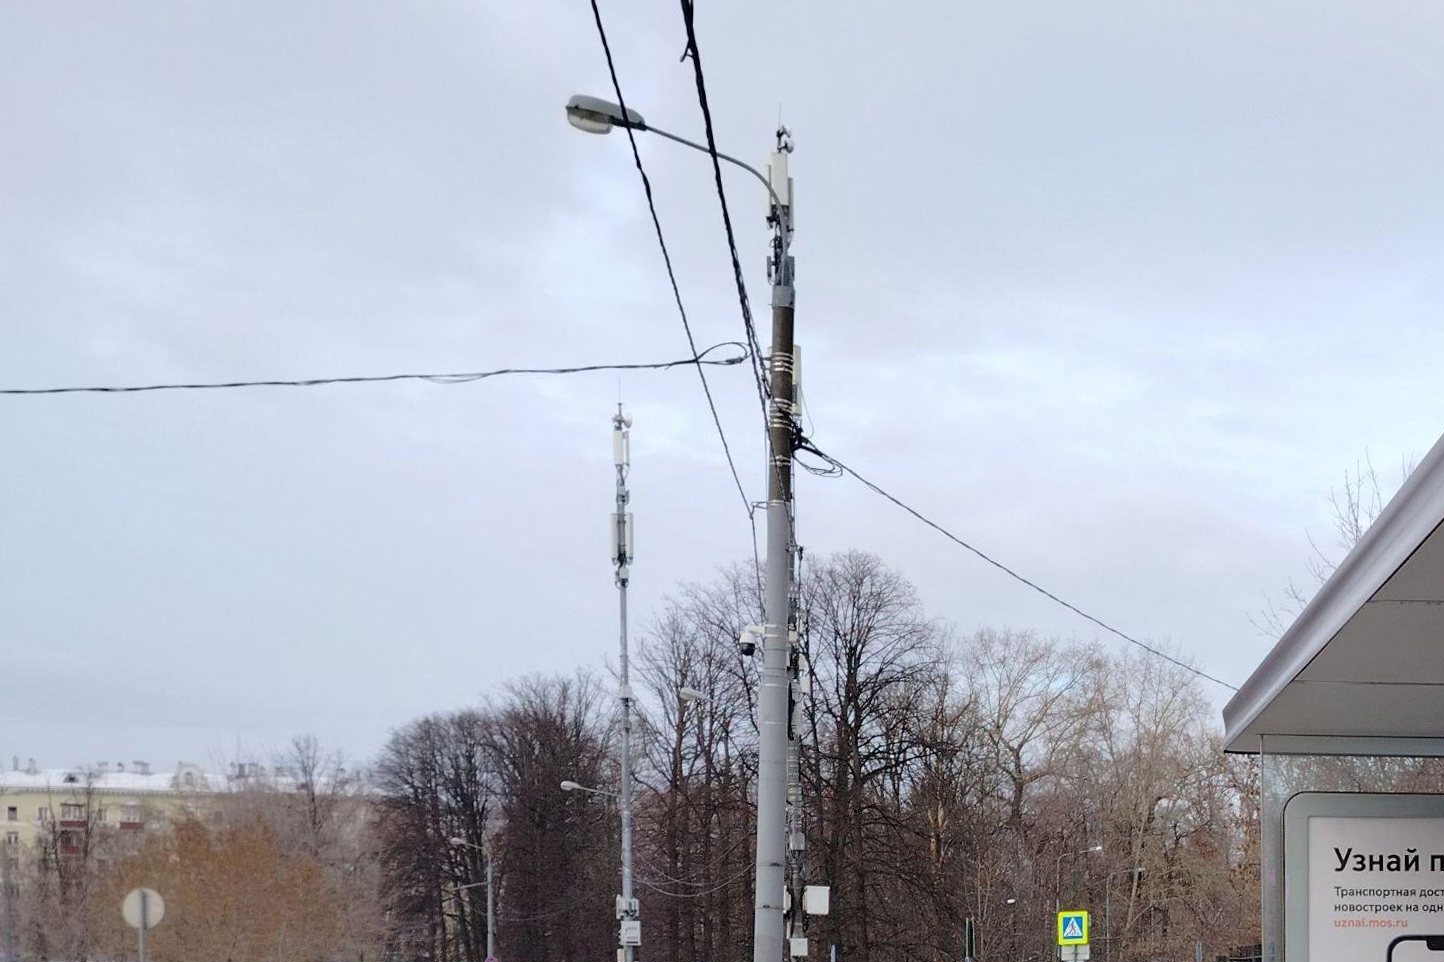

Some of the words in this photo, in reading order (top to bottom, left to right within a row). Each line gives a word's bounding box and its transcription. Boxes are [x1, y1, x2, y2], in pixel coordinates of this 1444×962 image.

[1333, 847, 1420, 872] Узнай
[1334, 886, 1416, 898] Транспортная
[1334, 903, 1403, 914] новостроек
[1405, 903, 1419, 912] на
[1333, 917, 1408, 928] uznai.mos.ru
